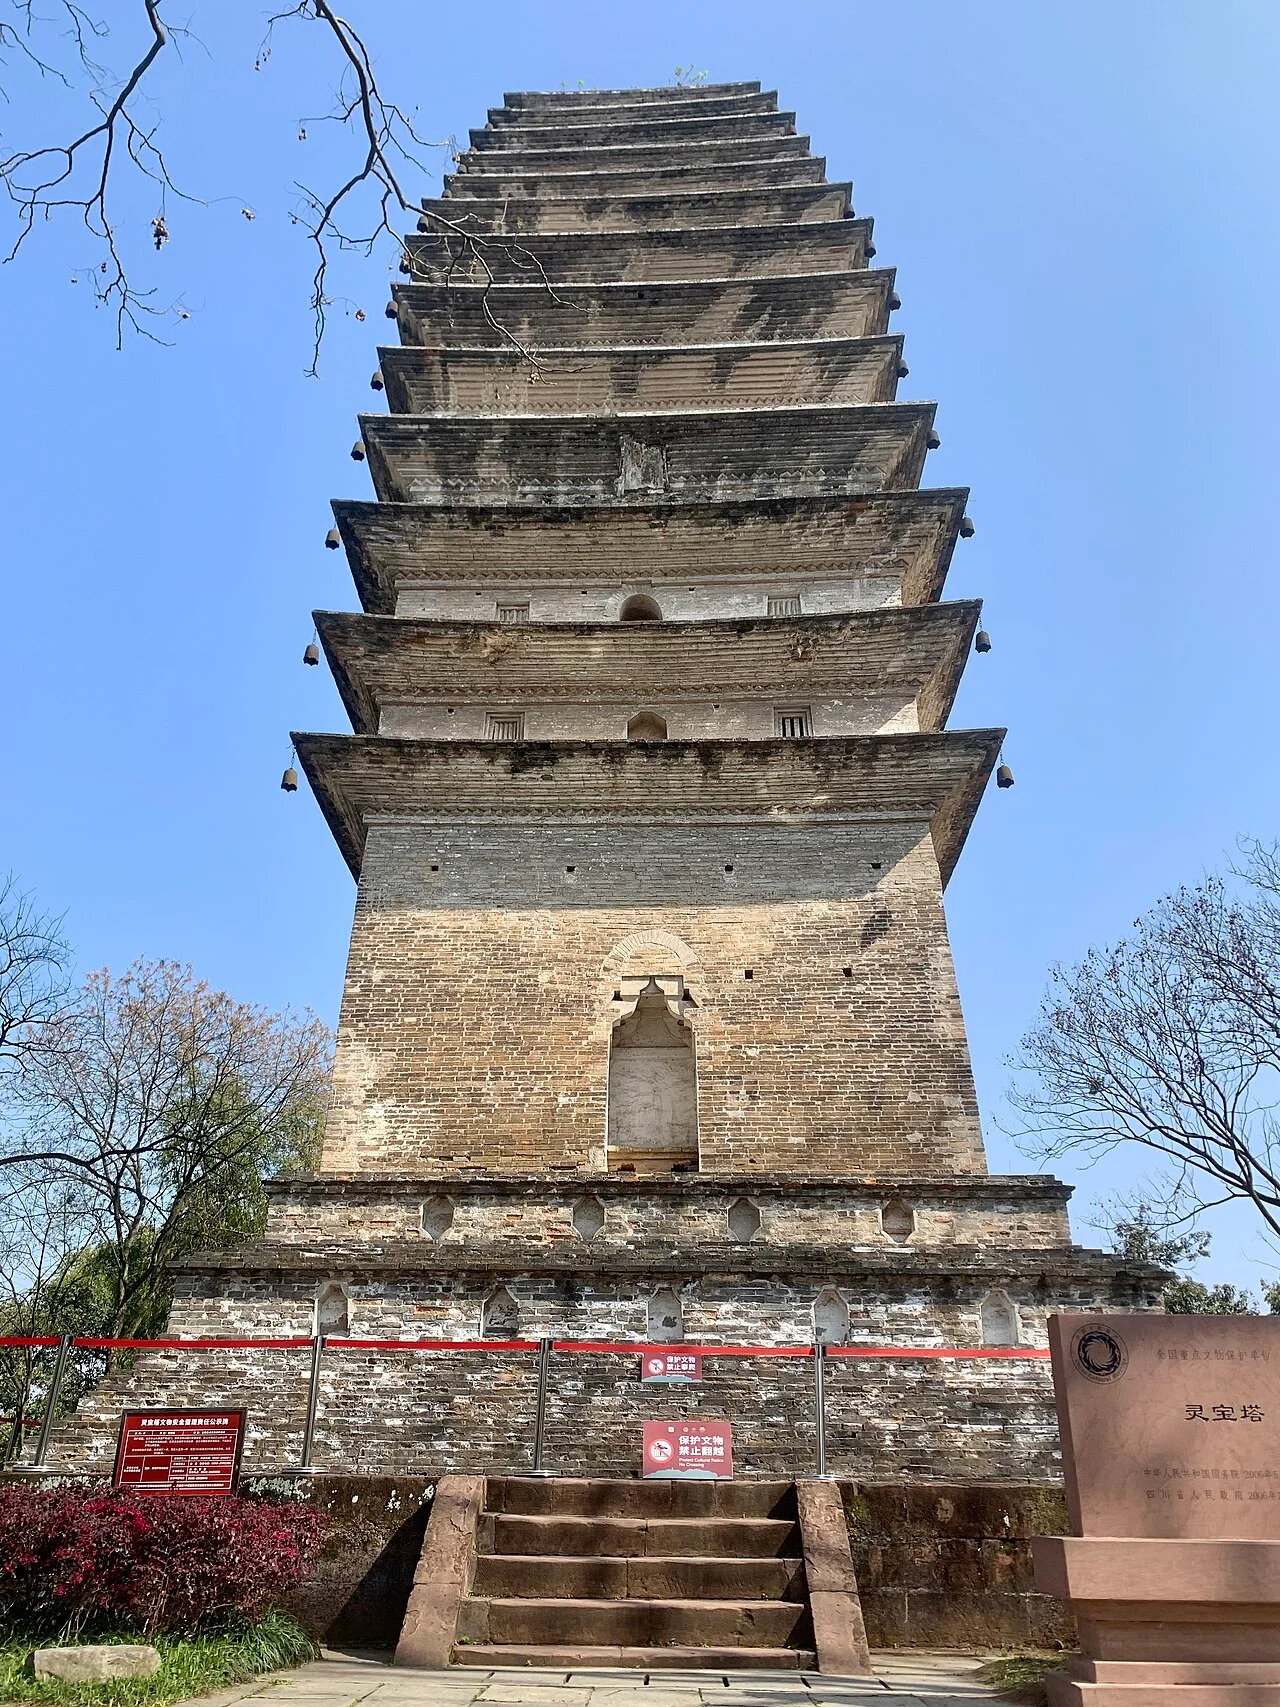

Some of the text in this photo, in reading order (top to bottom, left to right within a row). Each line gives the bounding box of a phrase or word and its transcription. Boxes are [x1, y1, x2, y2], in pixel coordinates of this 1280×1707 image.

[666, 1355, 696, 1364] 保护文物
[1156, 1349, 1271, 1361] 全国重点文物保护单位
[1184, 1403, 1265, 1422] 灵宝塔
[679, 1436, 723, 1445] 保护文物
[679, 1446, 724, 1455] 禁止翻越
[1143, 1467, 1240, 1479] 中华人民共和国国务院
[1146, 1489, 1243, 1501] 四川省人民政府
